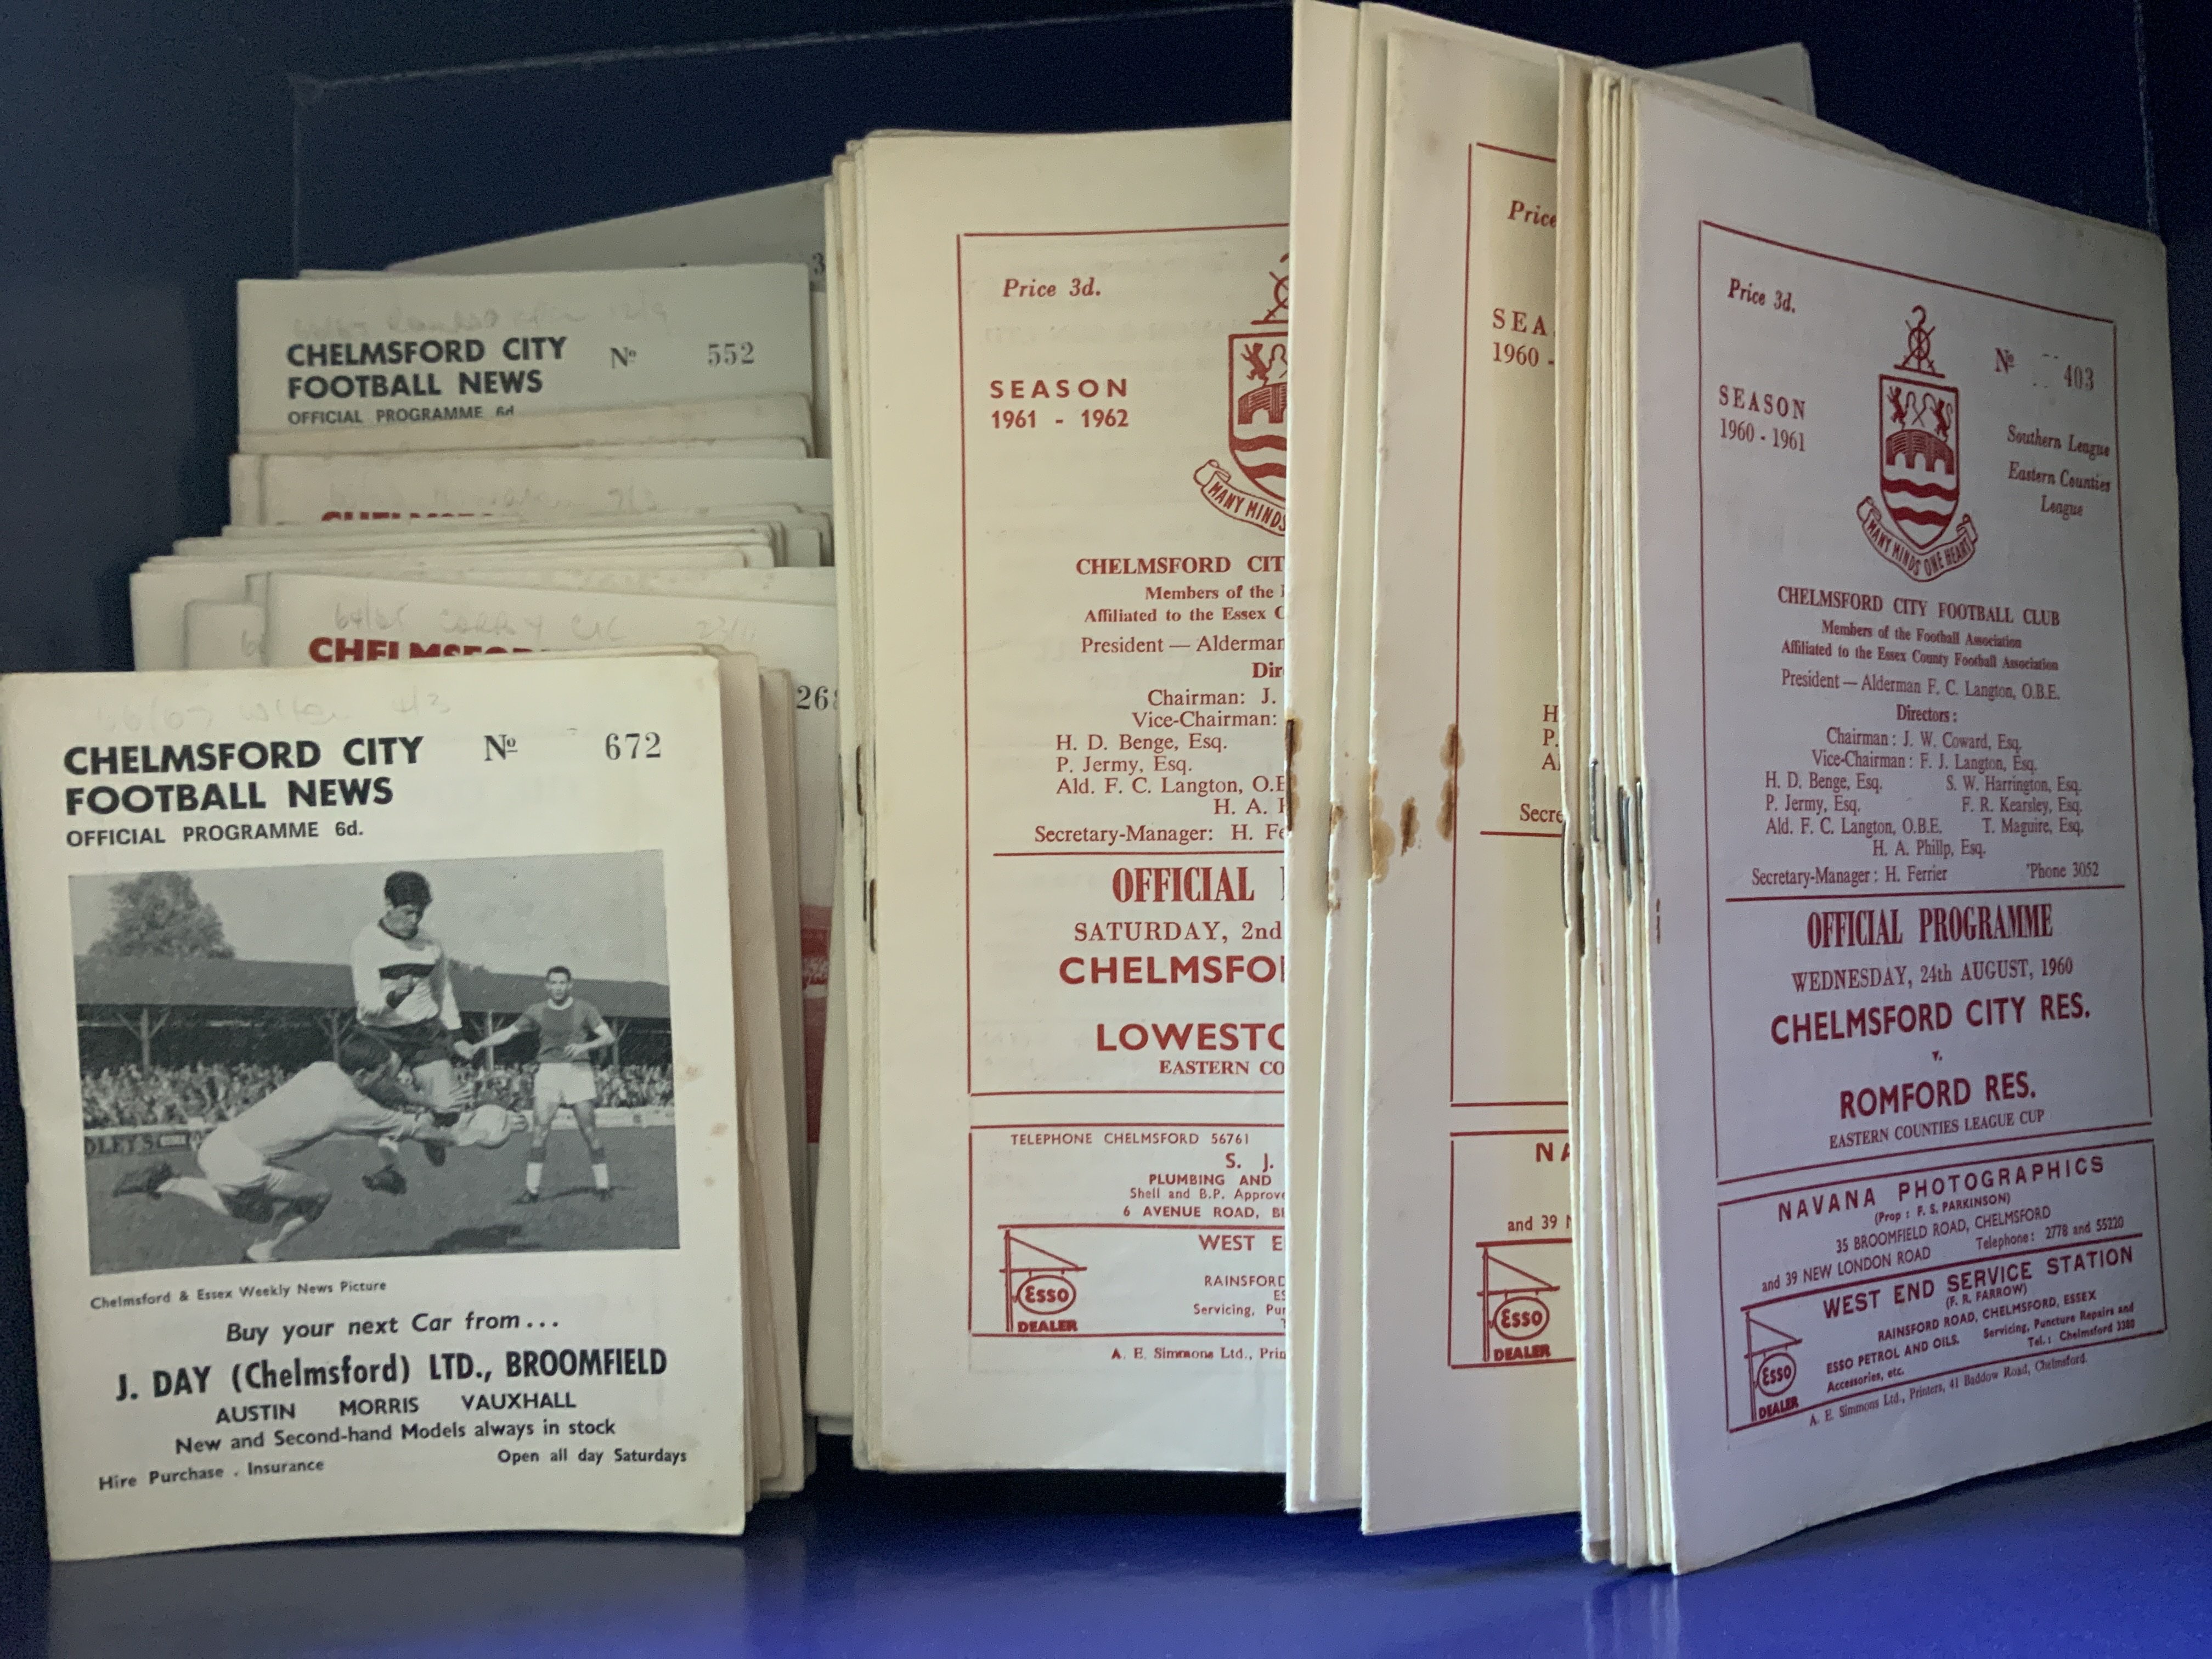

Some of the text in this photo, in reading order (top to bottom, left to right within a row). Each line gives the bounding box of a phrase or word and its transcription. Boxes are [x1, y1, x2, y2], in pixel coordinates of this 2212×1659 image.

[1508, 200, 1557, 228] Price
[1003, 276, 1101, 297] Price 3d.
[1728, 278, 1796, 313] Price 3d.
[286, 336, 567, 367] CHELMSFORD CITY
[708, 341, 754, 366] 552
[1493, 342, 1539, 367] 1960
[288, 369, 543, 399] FOOTBALL NEWS
[990, 378, 1127, 399] SEASON
[287, 405, 483, 425] OFFICIAL PROGRAMME
[1719, 384, 1805, 420] SEASON
[991, 409, 1036, 429] 1961
[1081, 408, 1128, 428] 1962
[1720, 418, 1755, 443] 1960
[1773, 427, 1805, 452] 1961
[2007, 424, 2111, 461] Southern League
[2007, 461, 2111, 493] Eastern Counties
[2040, 494, 2084, 521] League
[1076, 555, 1285, 575] CHELMSFORD CIT
[1146, 584, 1274, 600] Members of the
[1778, 585, 2060, 627] CHELMSFORD CITY FOOTBALL CLUB
[1085, 607, 1266, 623] Affiliated to the Essex
[64, 736, 424, 776] CHELMSFORD CITY
[605, 732, 661, 760] 672
[1057, 732, 1227, 754] H. D. Benge, Esq.
[66, 776, 393, 816] FOOTBALL NEWS
[1945, 775, 2083, 797] S. W. Harrington, Esq.
[66, 820, 363, 847] OFFICIAL PROGRAMME 6d.
[1035, 824, 1253, 847] Secretary-Manager: H.
[1112, 866, 1255, 903] OFFICIAL
[1075, 921, 1282, 944] SATURDAY, 2nd
[1807, 903, 2053, 949] OFFICIAL PROGRAMME
[1059, 955, 1285, 985] CHELMSFO
[1791, 956, 2073, 992] WEDNESDAY, 24th AUGUST, 1960
[1771, 991, 2090, 1045] CHELMSFORD CITY RES.
[1097, 1023, 1285, 1051] LOWESTO
[1159, 1060, 1249, 1075] EASTERN
[1840, 1070, 2036, 1120] ROMFORD RES.
[1011, 1132, 1249, 1146] TELEPHONE CHELMSFORD 56761
[1830, 1108, 2045, 1149] EASTERN COUNTIES LEAGUE CUP
[1149, 1173, 1272, 1186] PLUMBING AND
[1778, 1155, 2104, 1222] NAVANA PHOTOGRAPHICS
[1123, 1205, 1259, 1219] 6 AVENUE ROAD,
[1508, 1214, 1558, 1232] and 39
[1198, 1234, 1255, 1251] WEST
[1836, 1205, 2051, 1254] 35 BROOMFIELD ROAD, CHELMSFORD
[1762, 1246, 1931, 1293] and 39 NEW LONDON ROAD
[1822, 1246, 2132, 1319] WEST END SERVICE STATION
[90, 1280, 386, 1310] Chelmsford & Essex Weekly News Picture
[227, 1323, 269, 1346] Buy
[283, 1323, 335, 1345] your
[348, 1317, 398, 1335] next
[411, 1313, 452, 1333] Car
[1017, 1320, 1078, 1333] DEALER
[1877, 1290, 2097, 1342] RAINSFORD ROAD, CHELMSFORD, ESSEX
[1493, 1344, 1551, 1362] DEALER
[1826, 1334, 1960, 1375] ESSO PETROL AND OILS.
[116, 1348, 667, 1402] J. DAY (Chelmsford) LTD., BROOMFIELD
[216, 1392, 577, 1424] AUSTIN MORRIS VAUXHALL
[176, 1418, 616, 1454] New and Second-hand Models always in stock
[497, 1448, 687, 1466] Open all day Saturdays
[99, 1461, 324, 1491] Hire Purchase Insurance
